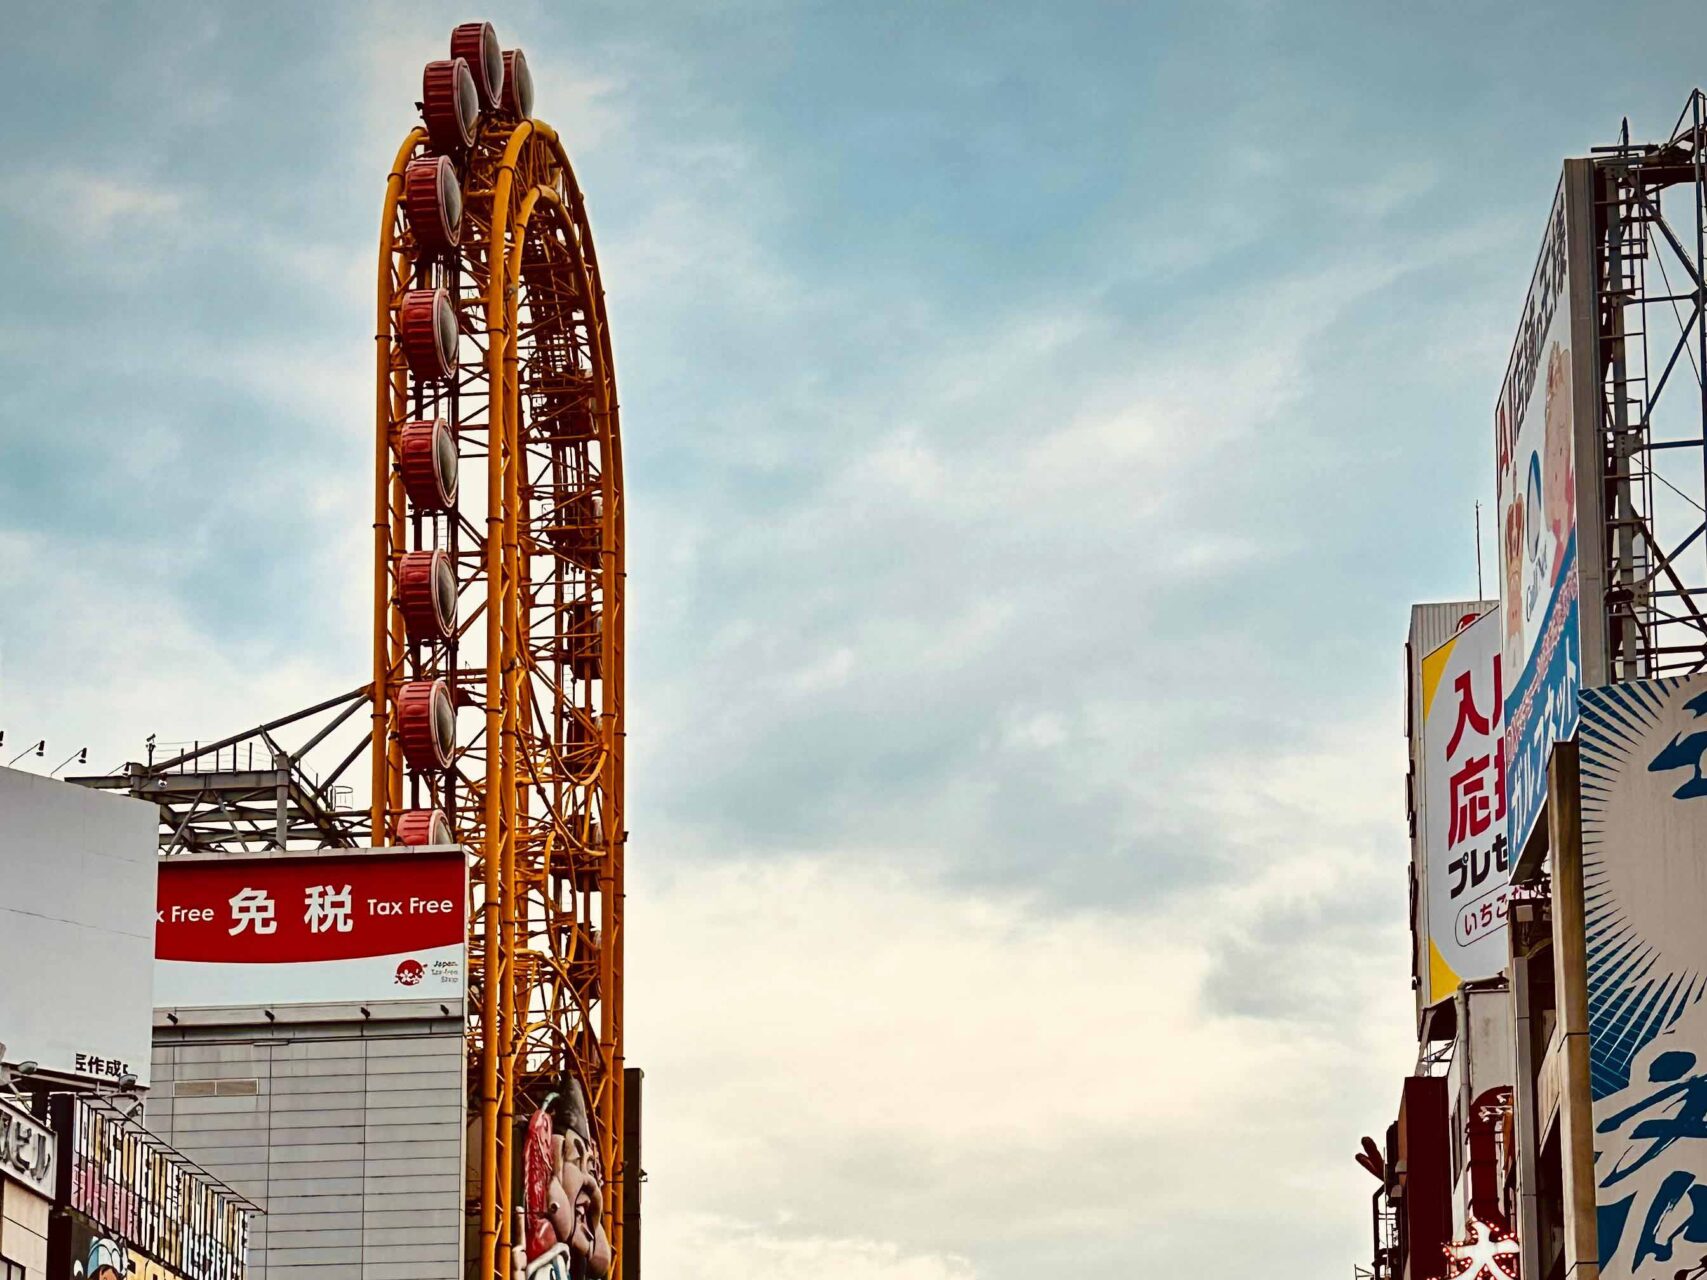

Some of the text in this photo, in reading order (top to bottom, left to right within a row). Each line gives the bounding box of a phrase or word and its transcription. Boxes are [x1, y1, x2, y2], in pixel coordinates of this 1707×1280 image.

[170, 905, 215, 923] Free
[367, 896, 454, 916] Tax Free
